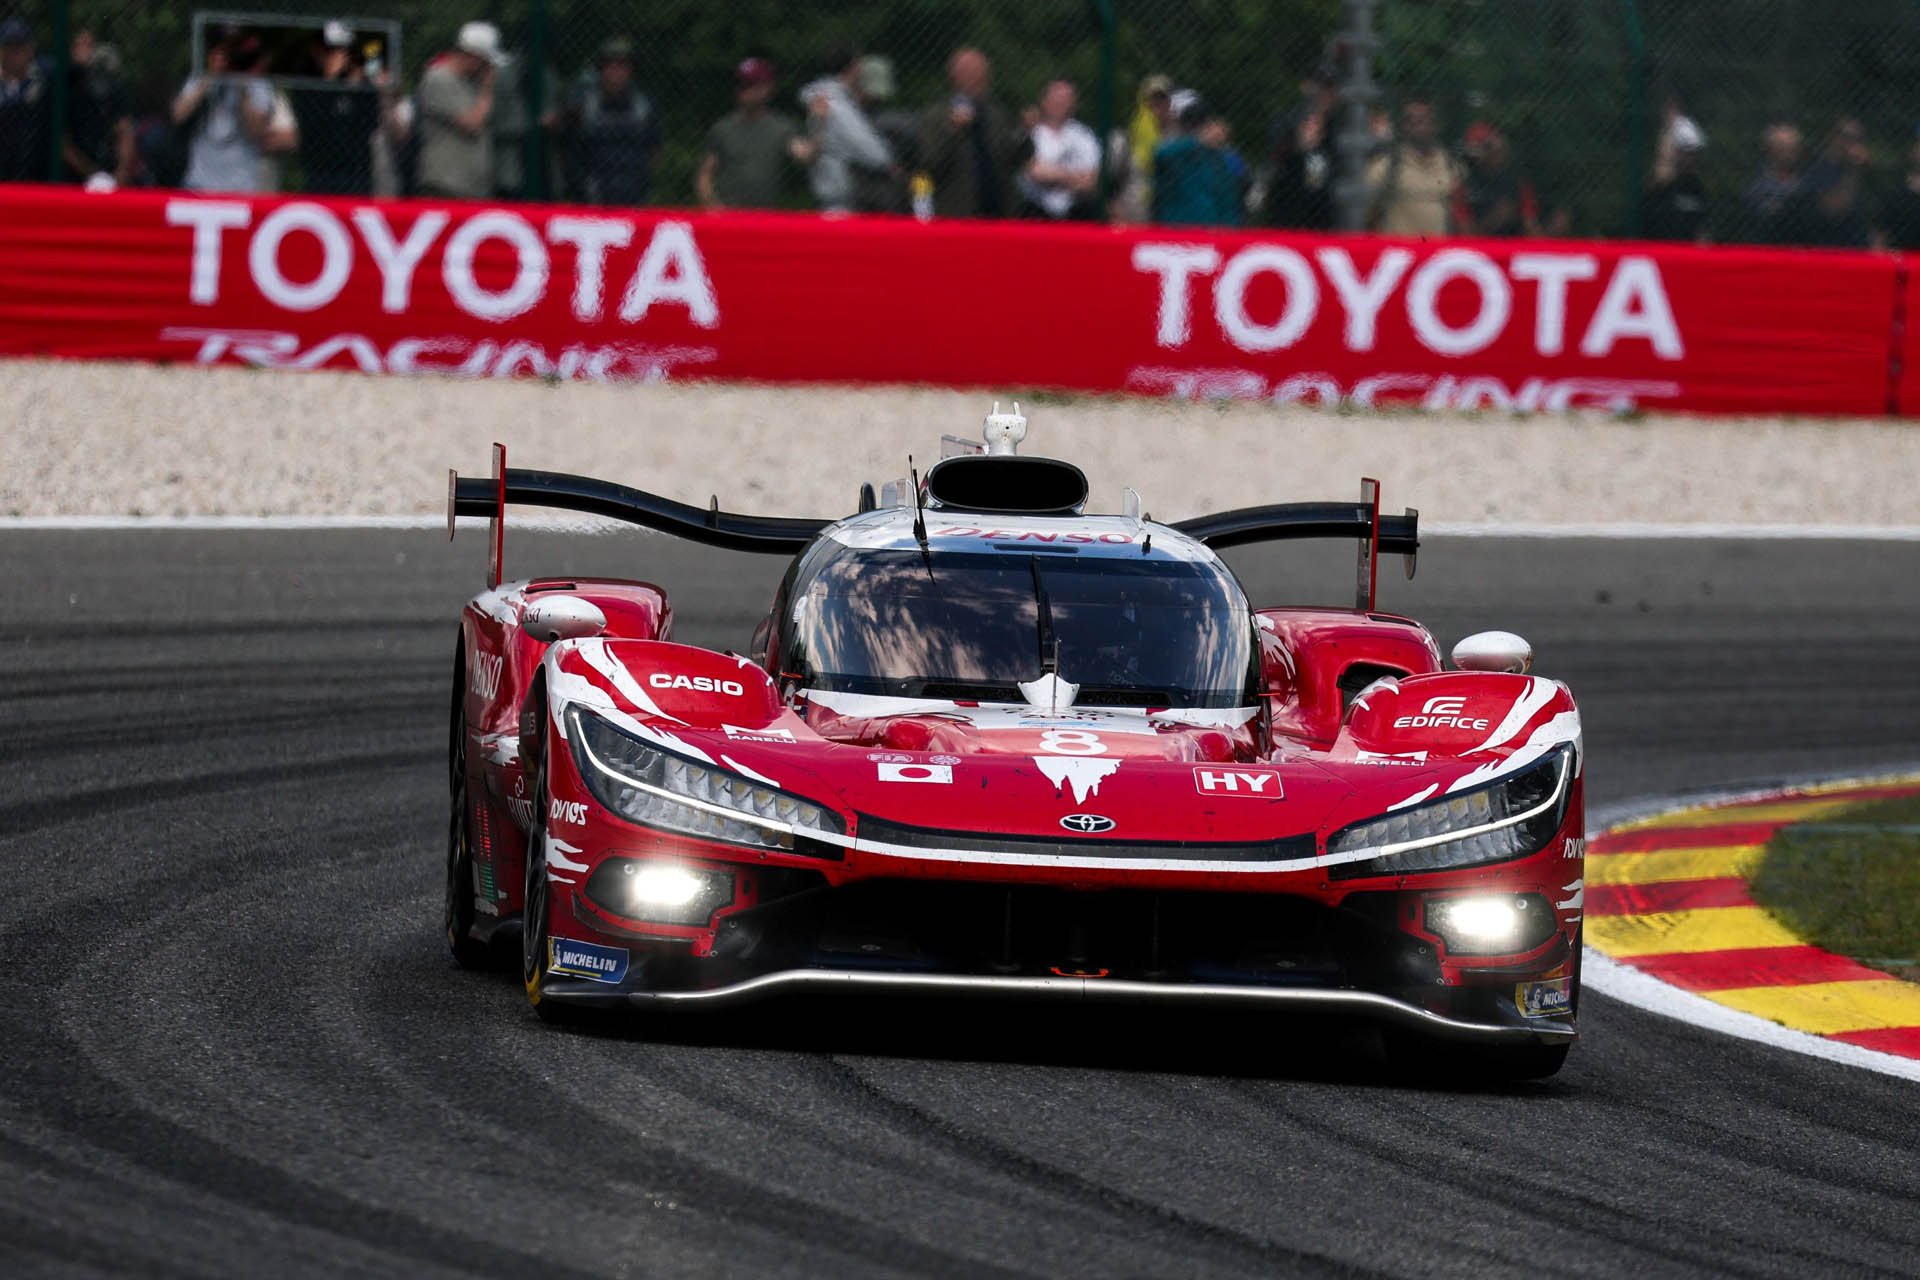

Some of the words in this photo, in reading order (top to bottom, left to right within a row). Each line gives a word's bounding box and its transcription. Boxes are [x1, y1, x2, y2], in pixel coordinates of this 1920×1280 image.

[166, 201, 720, 328] TOYOTA
[1131, 243, 1685, 361] TOYOTA
[934, 526, 1134, 545] DENSO
[649, 673, 744, 696] CASIO
[1393, 716, 1489, 731] EDIFICE
[727, 734, 798, 745] MARELLI
[1039, 730, 1108, 756] 8
[1200, 771, 1273, 792] HY
[562, 951, 617, 972] MICHELIN
